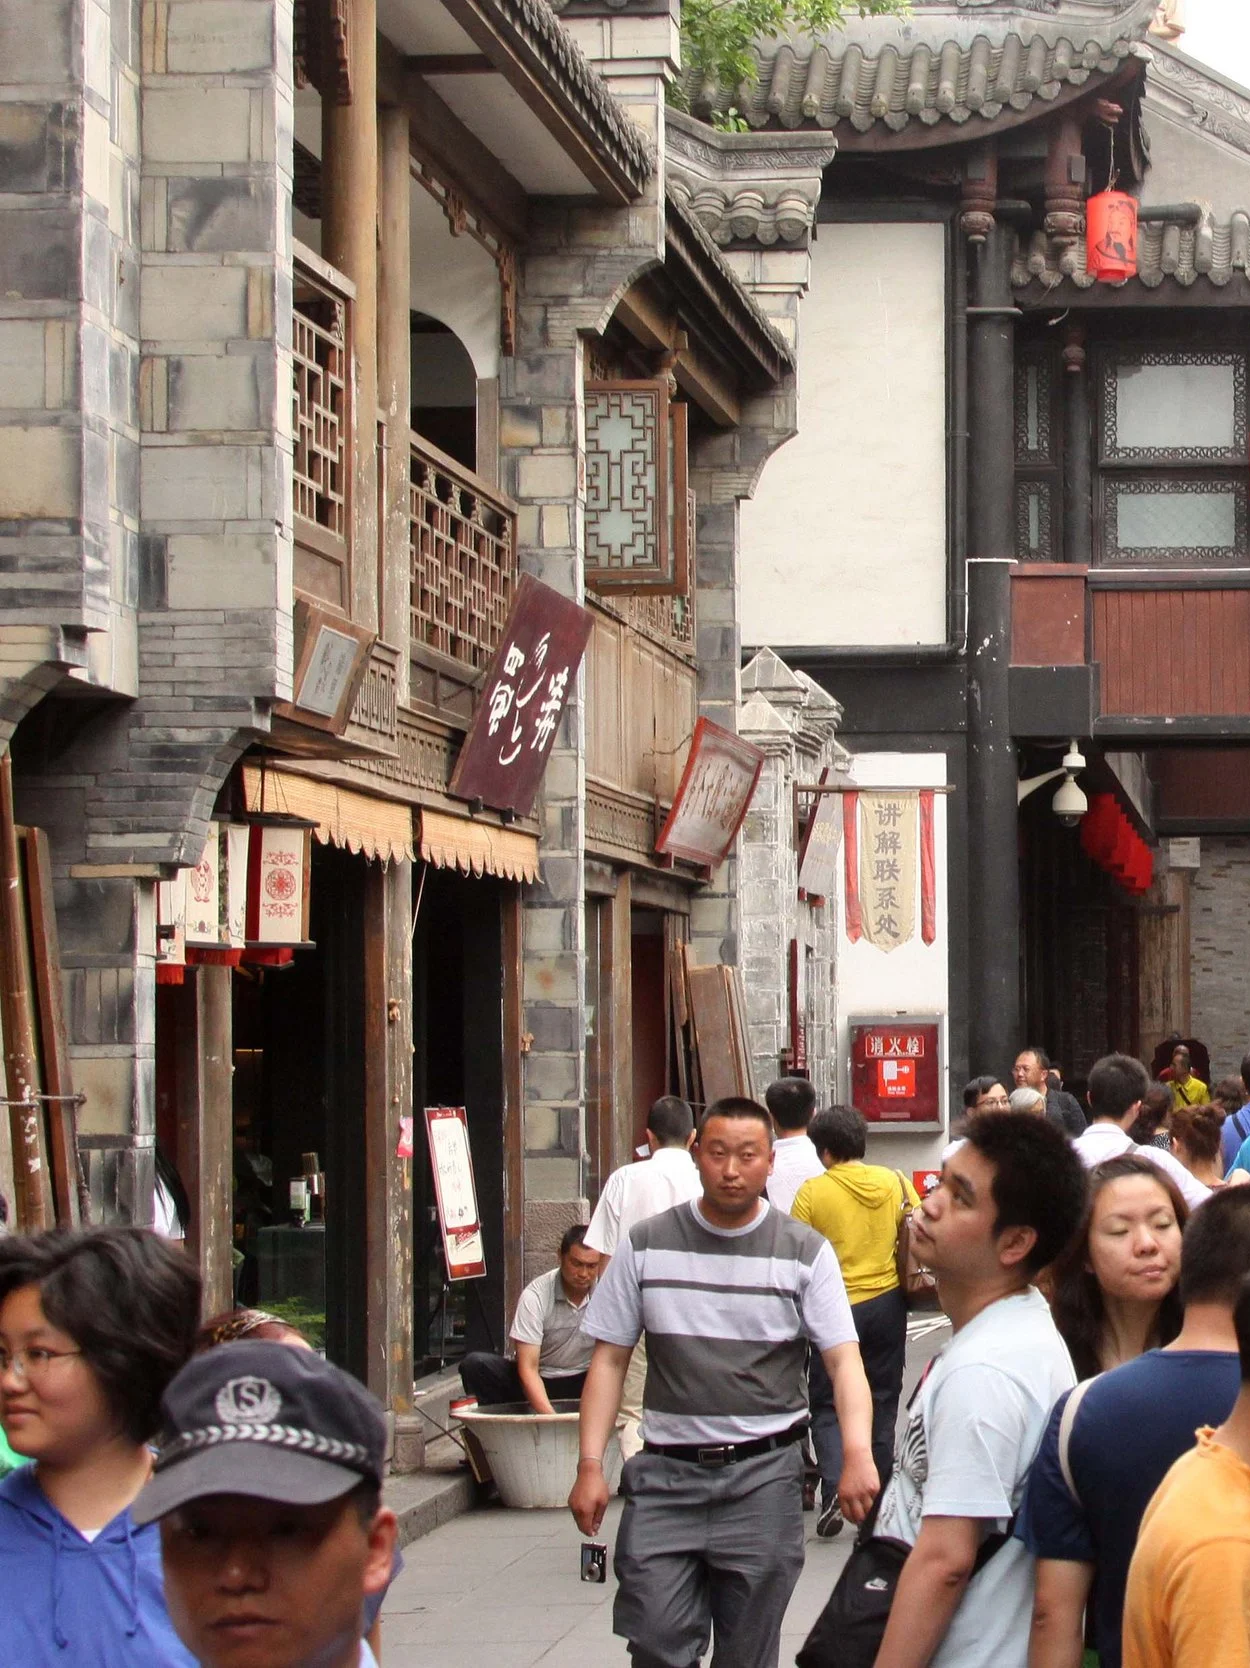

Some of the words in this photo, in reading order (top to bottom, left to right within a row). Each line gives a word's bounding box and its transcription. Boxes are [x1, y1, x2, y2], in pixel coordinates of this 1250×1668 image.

[873, 803, 902, 938] 讲解联系处
[870, 1036, 920, 1055] 消火栓
[239, 1382, 262, 1415] S
